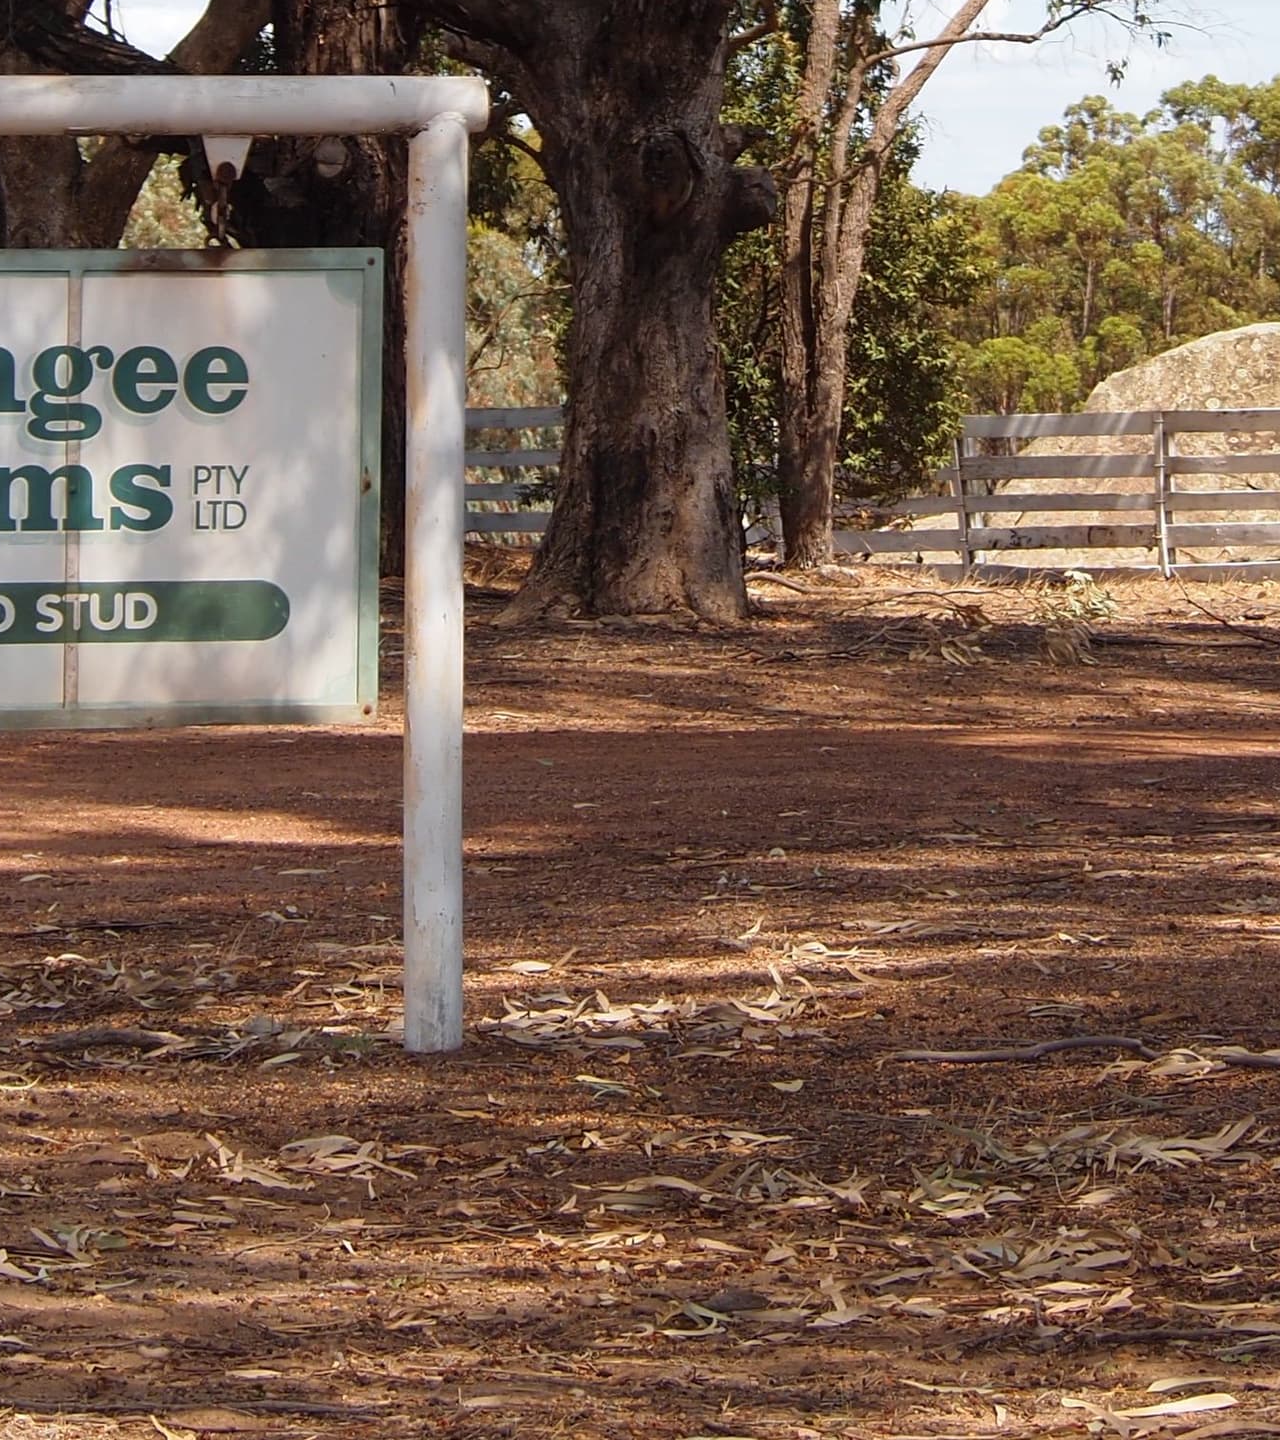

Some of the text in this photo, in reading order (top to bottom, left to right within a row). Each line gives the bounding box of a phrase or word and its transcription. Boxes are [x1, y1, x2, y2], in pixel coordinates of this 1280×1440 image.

[192, 465, 249, 495] PTY
[194, 500, 248, 531] LTD
[35, 592, 158, 632] STUD
